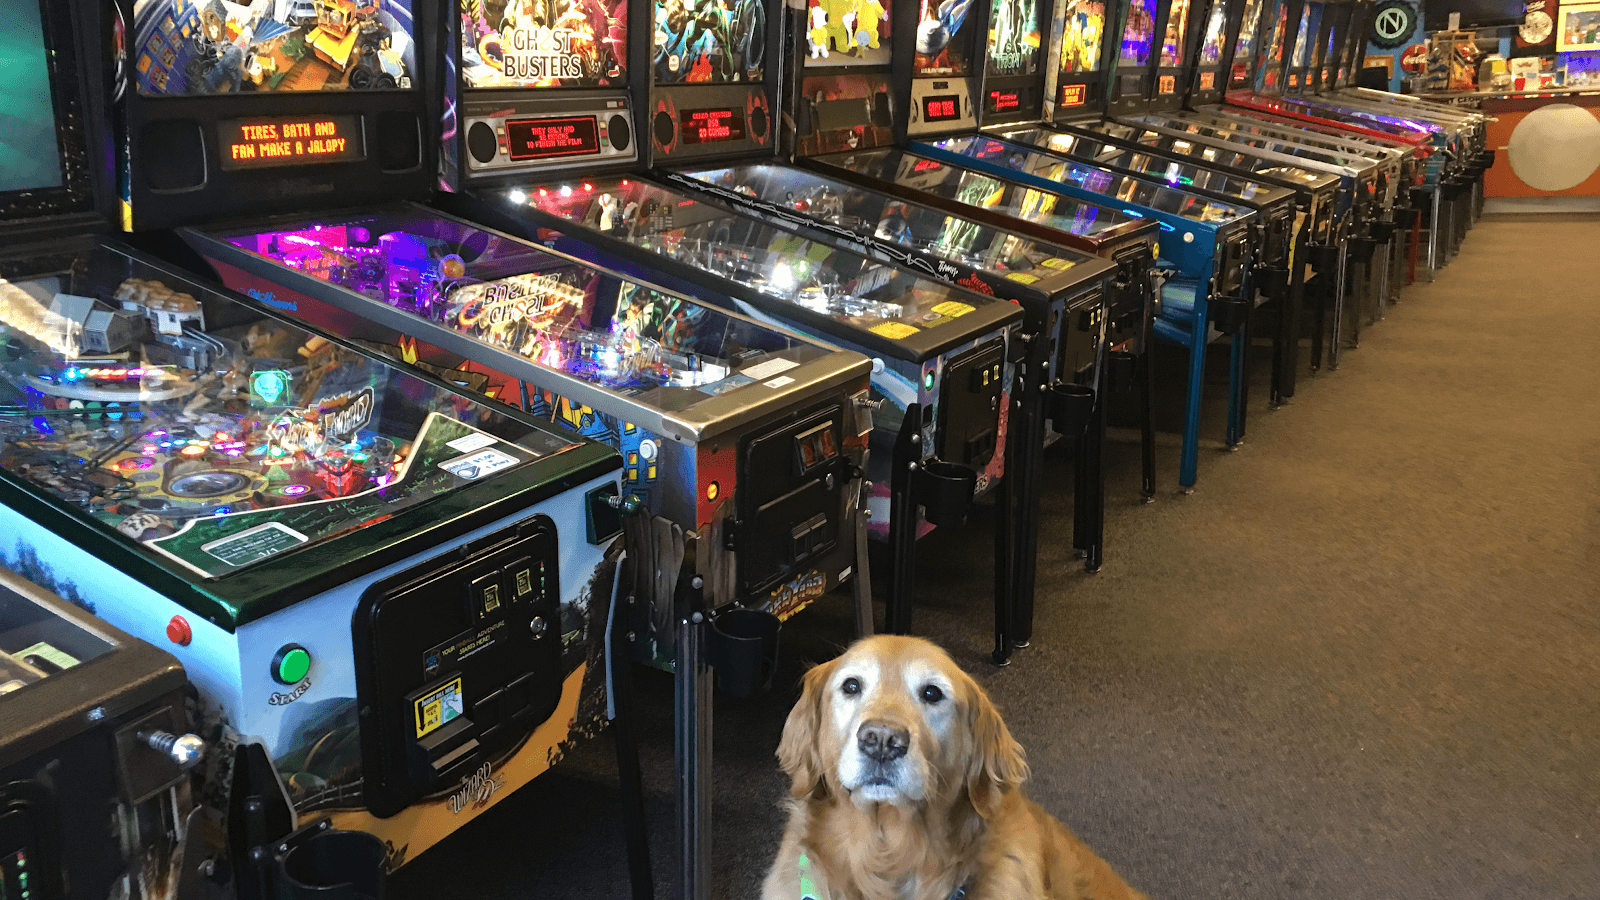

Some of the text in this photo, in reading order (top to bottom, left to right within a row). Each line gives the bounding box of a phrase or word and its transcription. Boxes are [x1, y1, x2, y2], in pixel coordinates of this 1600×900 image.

[503, 54, 583, 78] BUSTERS
[241, 121, 336, 140] TIRES, BATH AND
[231, 138, 346, 160] FAN MAKE A JALOPY
[477, 620, 505, 639] ADVENTURE
[268, 677, 312, 706] START
[446, 761, 492, 814] WIZARD
